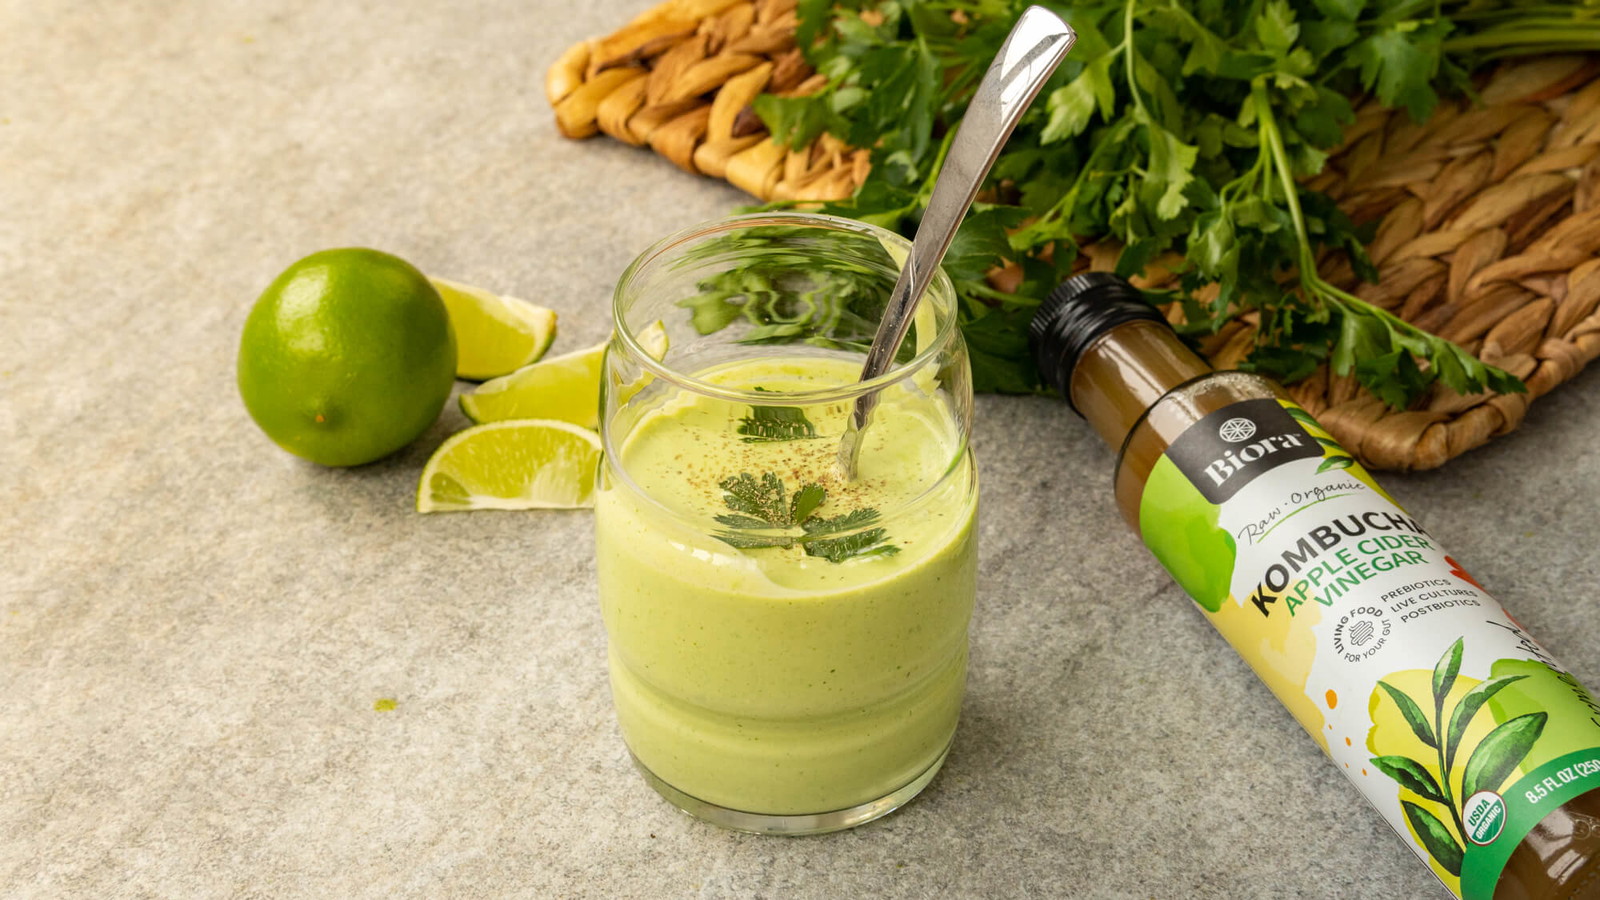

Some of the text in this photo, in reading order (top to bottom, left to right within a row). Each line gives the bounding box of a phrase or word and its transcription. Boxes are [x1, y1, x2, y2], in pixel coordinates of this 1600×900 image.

[1204, 434, 1304, 487] Biora
[1238, 480, 1366, 545] Raw Organic
[1251, 512, 1434, 618] KOMBUCHA
[1285, 534, 1436, 617] APPLE CIDER
[1313, 550, 1430, 608] VINEGAR
[1380, 579, 1452, 602] PREBIOTICS
[1390, 589, 1478, 613] LIVE CULTURES
[1400, 599, 1481, 623] POSTBIOTICS
[1334, 606, 1383, 654] LIVING FOOD
[1344, 619, 1392, 663] FOR YOUR GUT
[1525, 784, 1548, 804] 8.5
[1542, 777, 1563, 792] FL
[1556, 767, 1579, 783] OZ
[1468, 799, 1490, 827] USDA
[1475, 805, 1501, 840] ORGANIC
